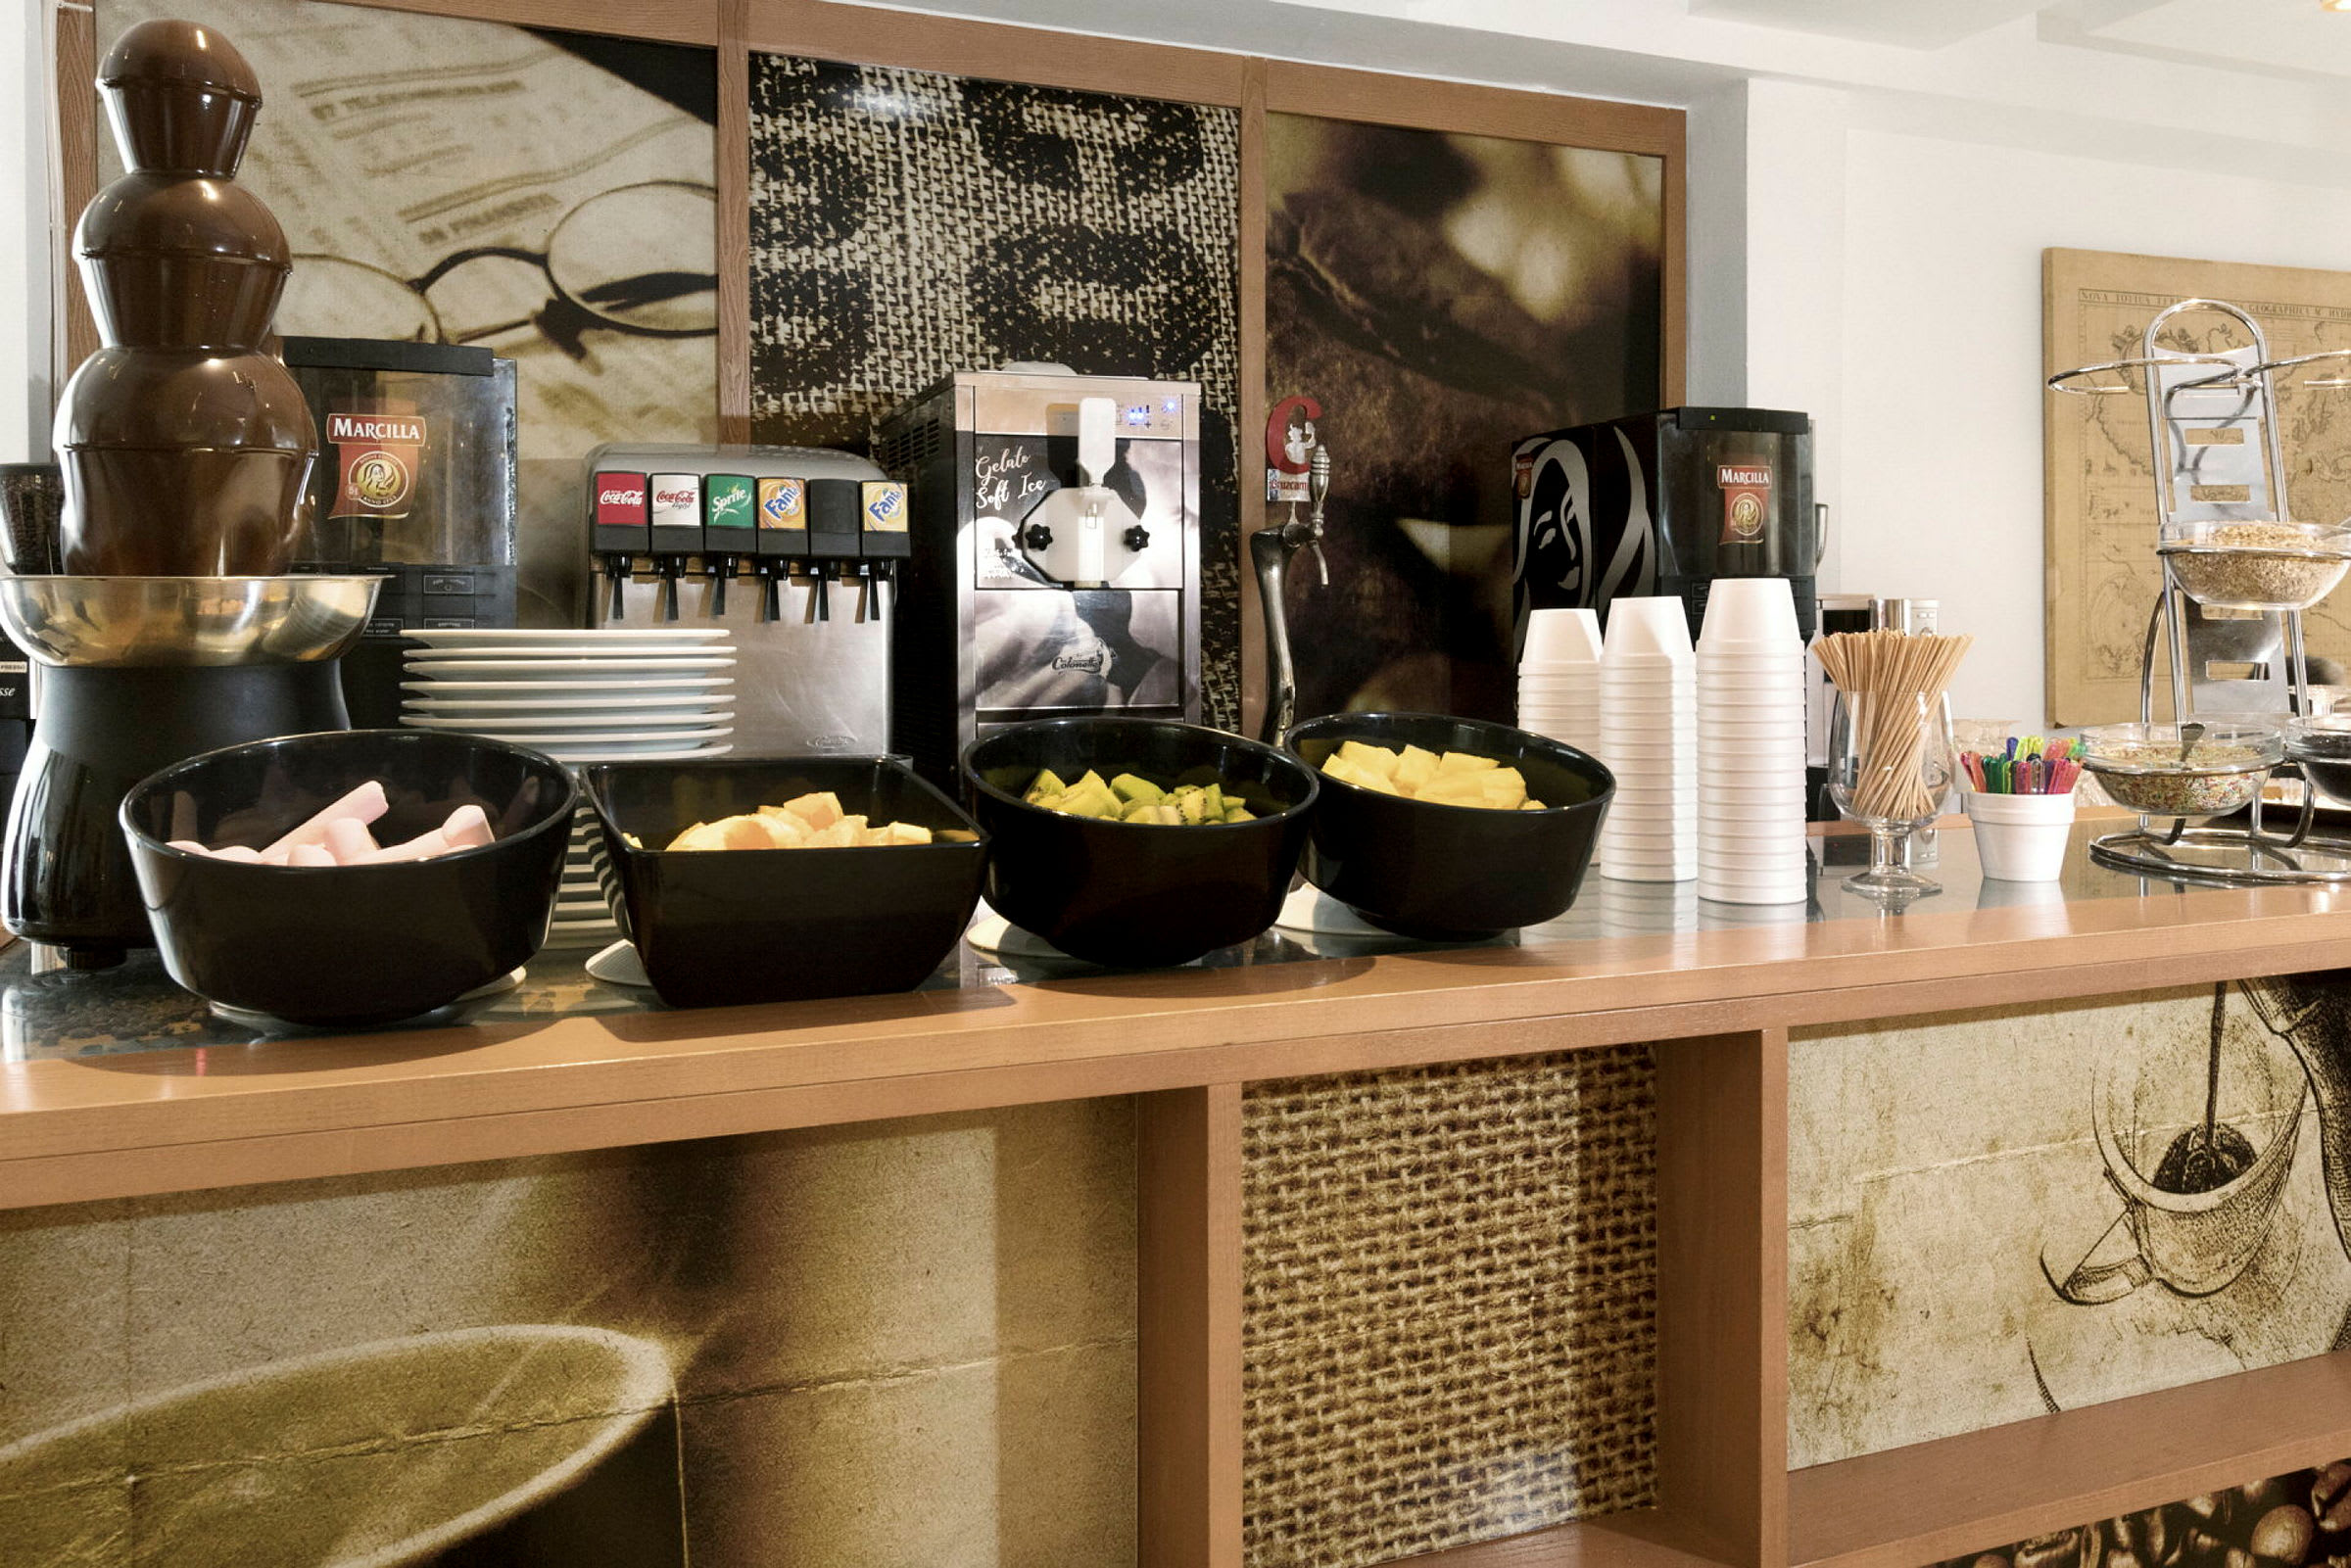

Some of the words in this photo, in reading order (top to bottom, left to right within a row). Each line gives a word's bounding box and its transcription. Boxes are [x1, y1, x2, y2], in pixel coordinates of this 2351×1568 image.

[334, 418, 419, 440] MARCILLA
[975, 445, 1031, 487] Gelato
[1721, 469, 1769, 484] MARCILLA
[712, 489, 747, 512] Sprite
[976, 479, 1010, 510] Soft
[1017, 471, 1046, 499] Ice
